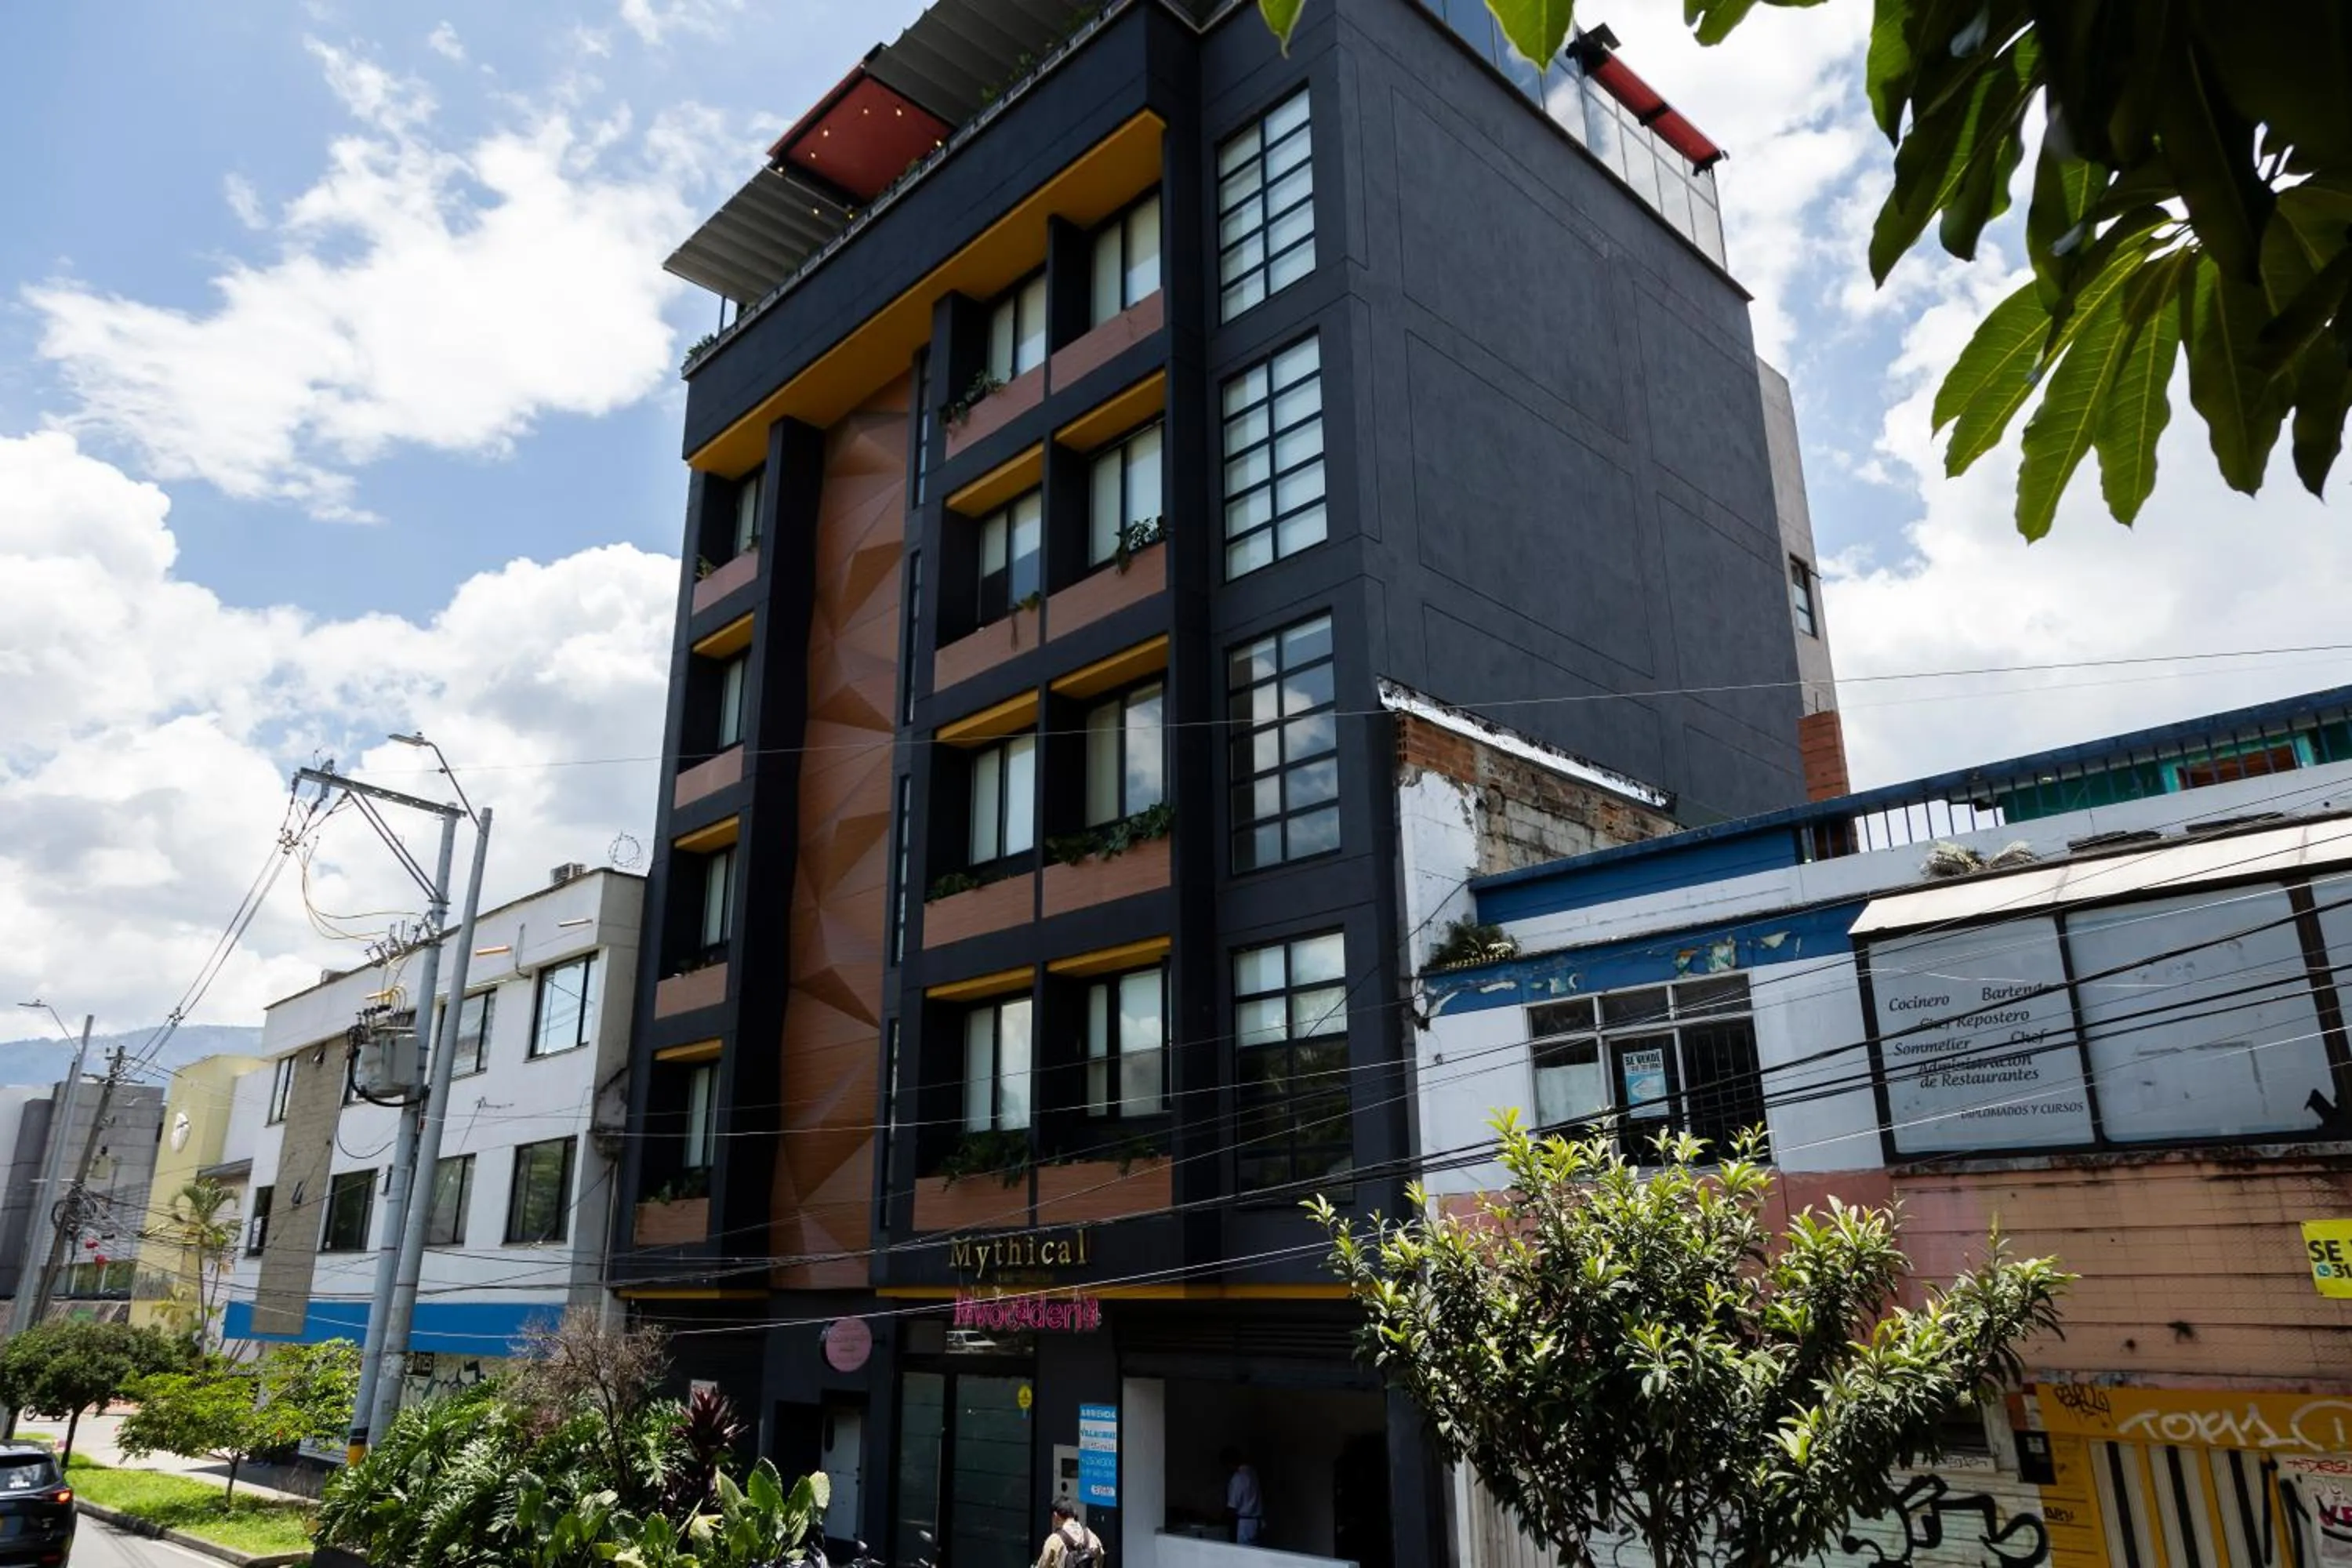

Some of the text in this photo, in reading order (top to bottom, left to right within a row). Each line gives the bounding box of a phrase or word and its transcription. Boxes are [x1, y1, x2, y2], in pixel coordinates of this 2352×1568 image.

[1889, 995, 1951, 1011] Cocinero
[1956, 1010, 2030, 1028] Repostero
[1893, 1038, 1972, 1056] Sommelier
[1920, 1067, 2039, 1089] de Restaurantes
[1961, 1102, 2084, 1120] DIPLOMADOS Y CURSOS
[949, 1229, 1087, 1279] Mythical
[2307, 1240, 2344, 1263] SE
